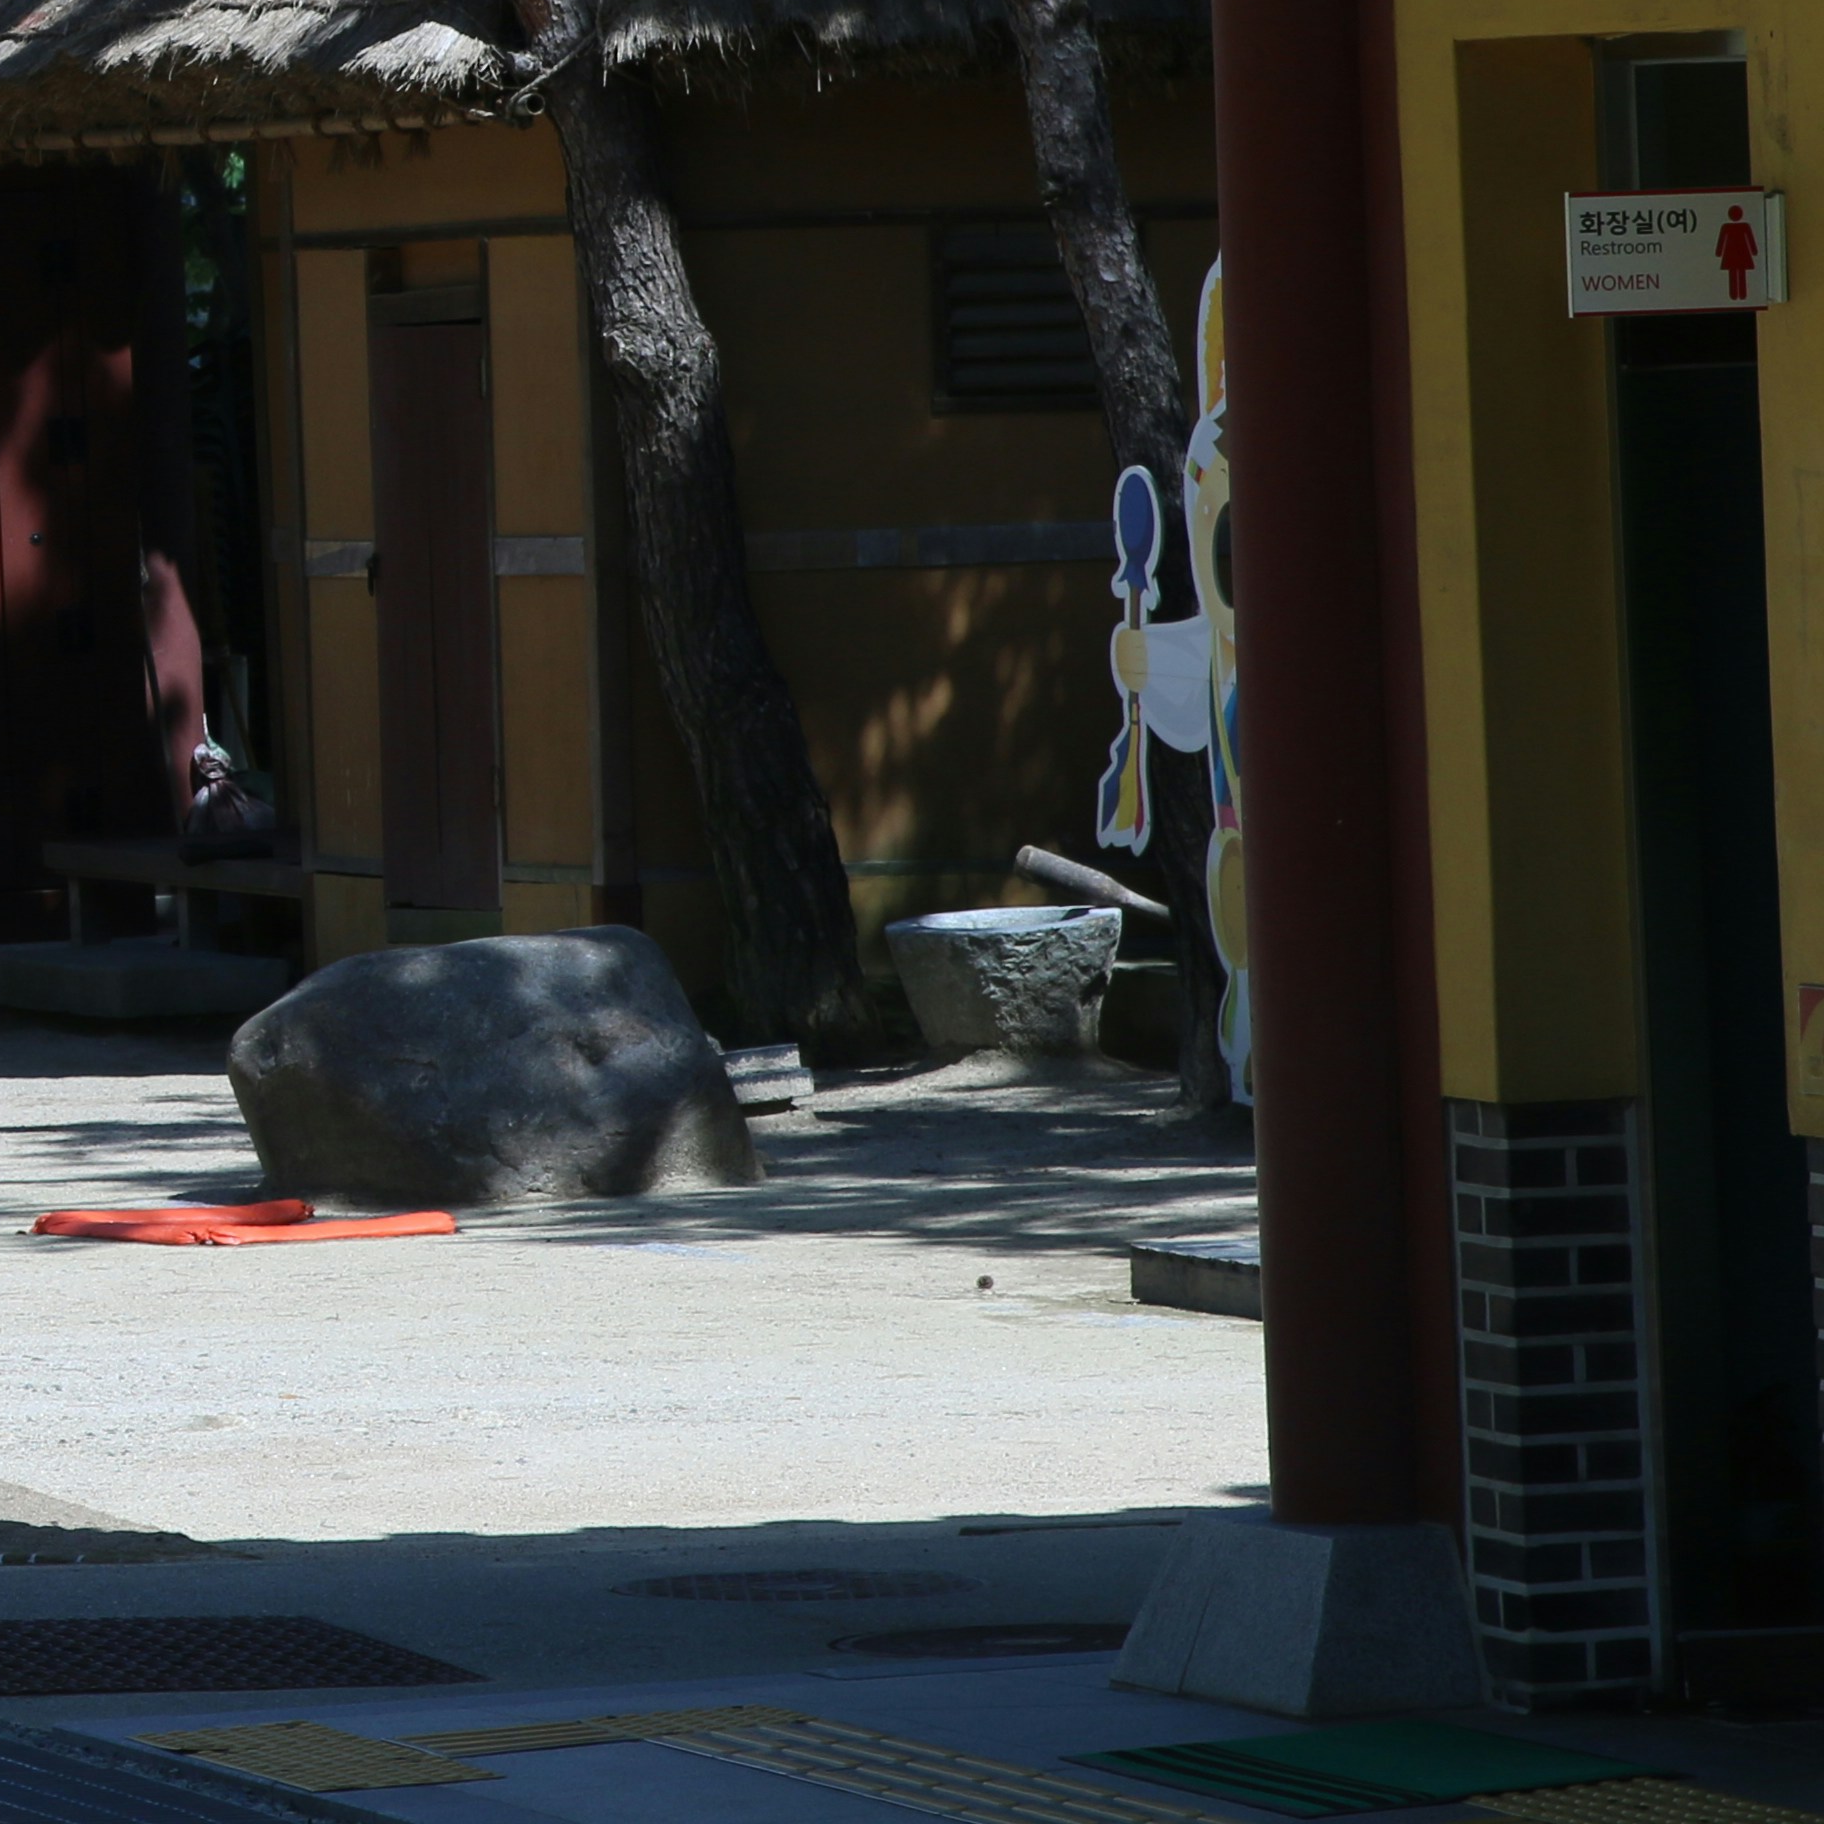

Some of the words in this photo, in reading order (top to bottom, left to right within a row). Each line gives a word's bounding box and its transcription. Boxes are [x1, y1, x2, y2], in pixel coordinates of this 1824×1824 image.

[1579, 208, 1698, 236] 화장실(여)
[1580, 239, 1663, 256] Restroom
[1581, 273, 1660, 292] WOMEN
